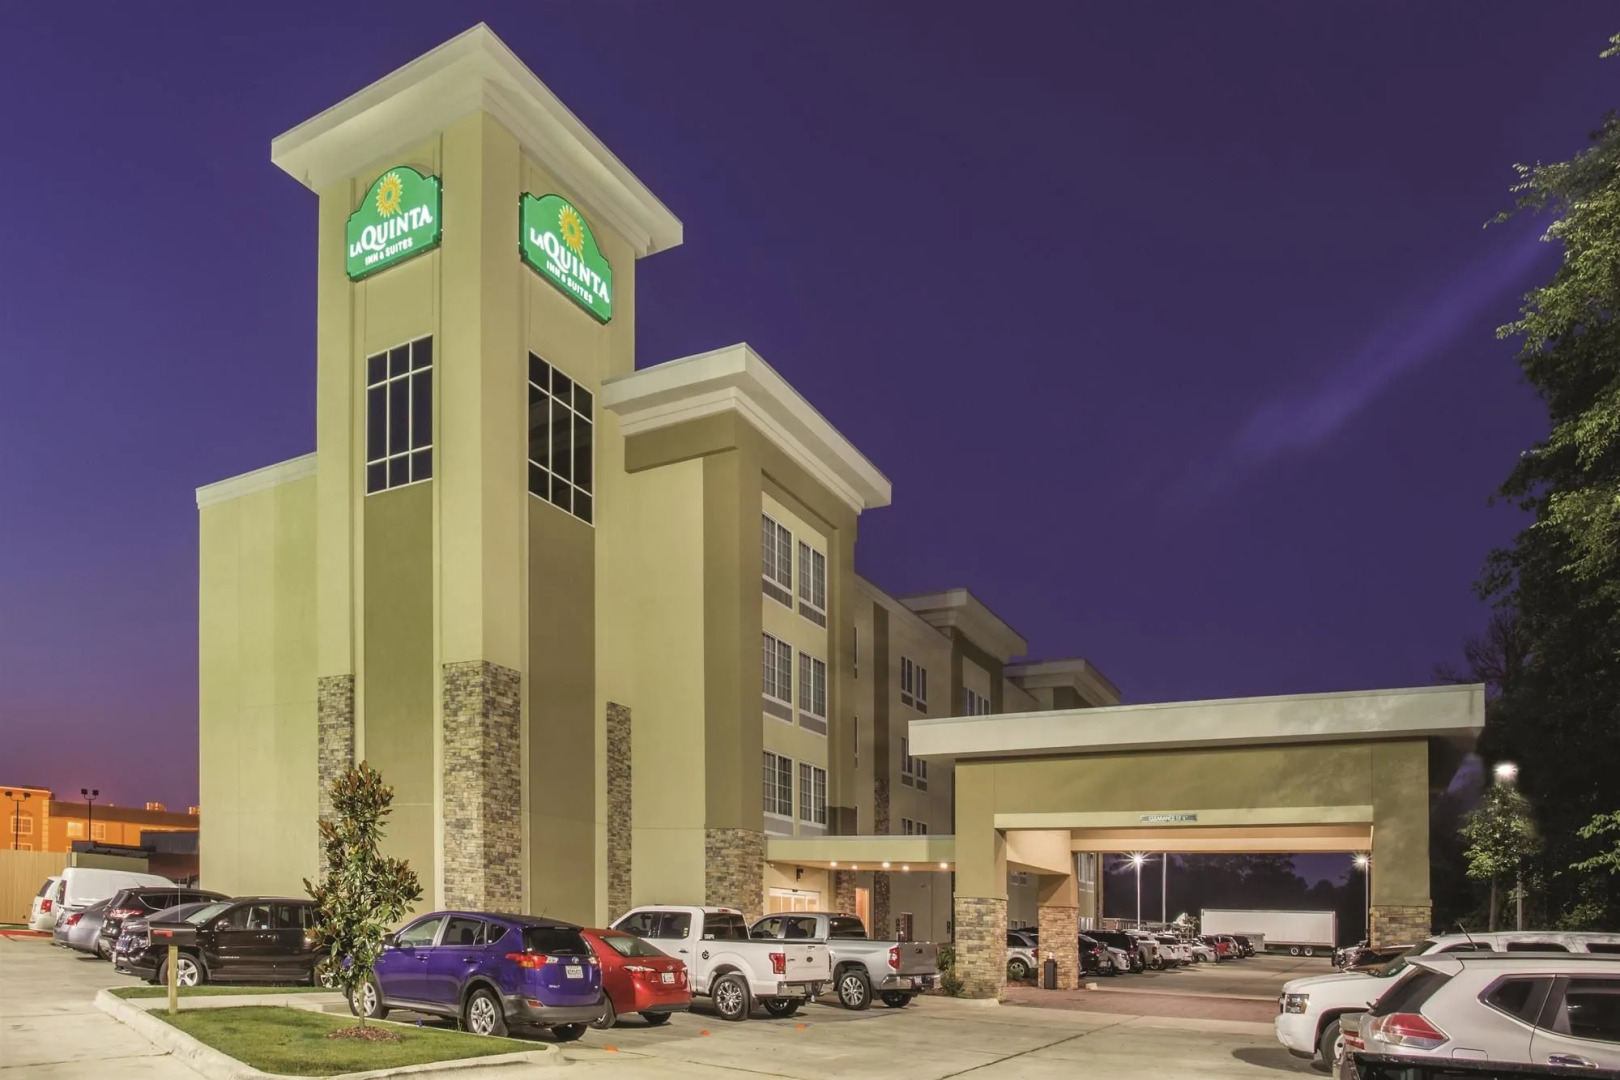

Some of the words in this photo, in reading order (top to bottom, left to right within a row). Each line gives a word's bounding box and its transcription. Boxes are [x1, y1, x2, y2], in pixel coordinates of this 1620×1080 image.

[350, 241, 363, 258] LA
[361, 204, 433, 251] QUINTA
[364, 252, 379, 266] INN
[379, 251, 385, 260] &
[385, 236, 413, 257] SUITES
[530, 227, 545, 251] LA
[543, 231, 610, 304] QUINTA
[546, 260, 561, 278] INN
[567, 277, 593, 304] SUITES
